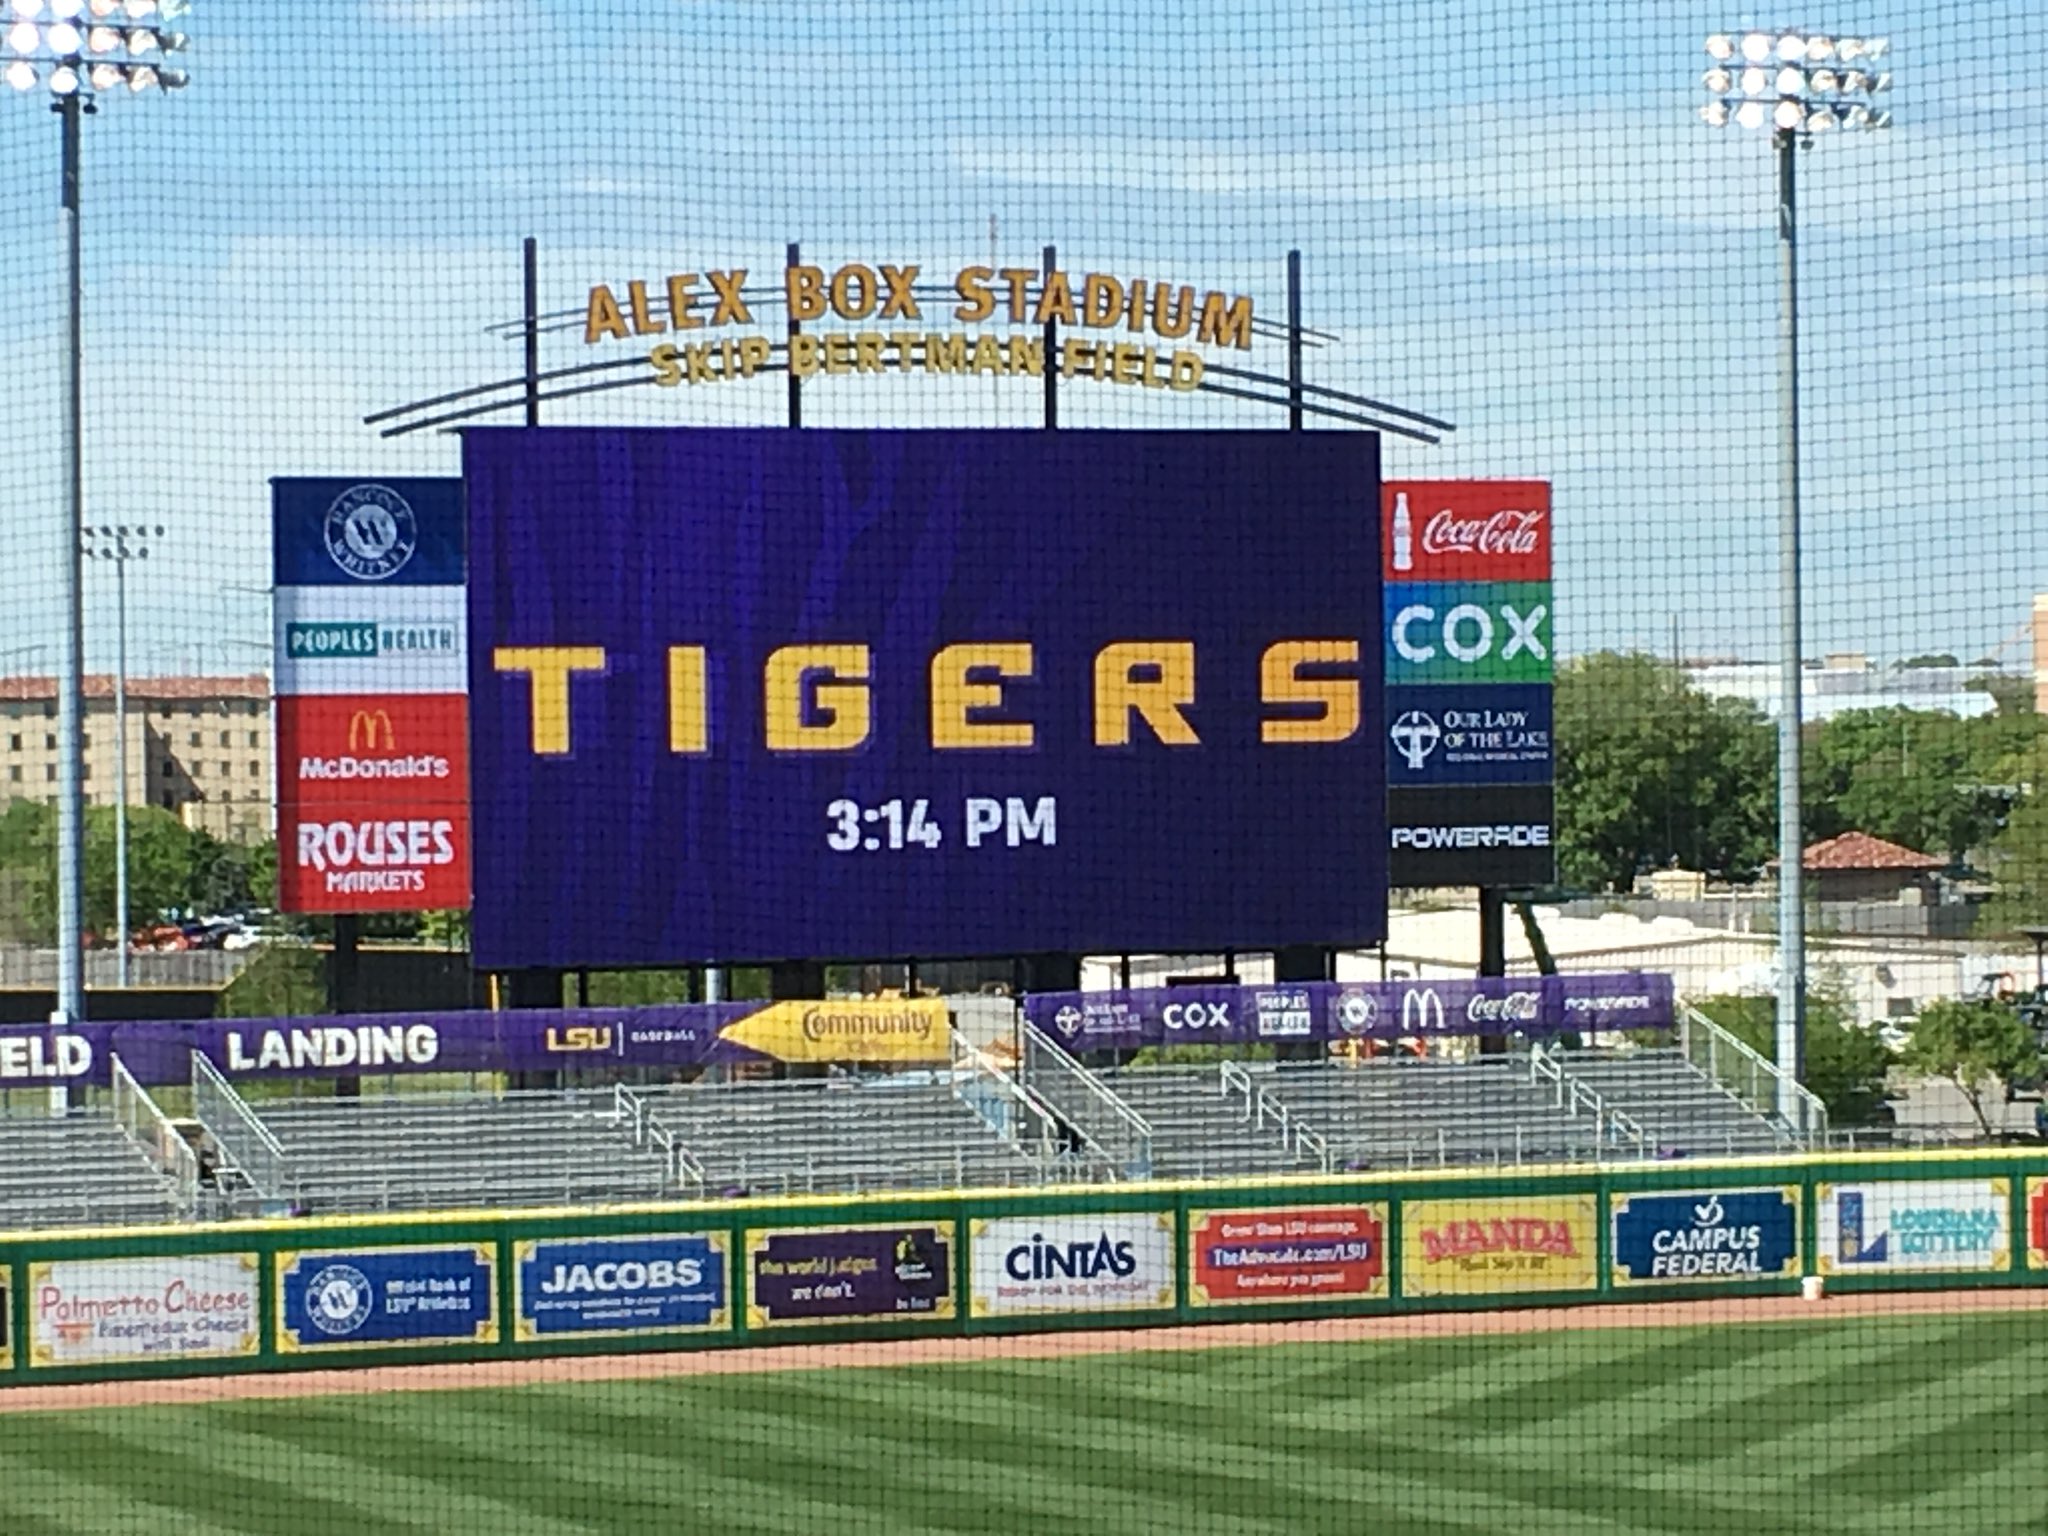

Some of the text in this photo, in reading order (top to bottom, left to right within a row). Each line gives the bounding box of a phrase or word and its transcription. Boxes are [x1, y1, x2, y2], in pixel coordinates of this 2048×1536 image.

[585, 263, 1255, 350] ALEX BOX STADIUM
[650, 333, 1204, 393] SKIP BERTMAN FIELD
[290, 626, 452, 653] PEOPLES HEALTH
[1391, 604, 1547, 663] COX
[493, 639, 1362, 757] TIGERS
[298, 756, 450, 781] McDonald's
[825, 796, 1057, 853] 3:14 PM
[1391, 825, 1550, 849] POWERADE
[297, 820, 454, 872] ROUSES
[326, 869, 426, 894] MARKETS
[803, 1010, 933, 1042] Community
[1163, 1002, 1231, 1029] COX
[227, 1024, 439, 1071] LANDING
[546, 1026, 612, 1052] LSU
[1890, 1208, 2000, 1230] LOUISIANA
[1420, 1216, 1582, 1266] MANDA
[1652, 1225, 1762, 1254] CAMPUS
[1901, 1229, 1995, 1254] LOTTERY
[541, 1257, 702, 1294] JACOBS
[1652, 1251, 1763, 1277] FEDERAL
[40, 1279, 251, 1321] Palmetto Cheese
